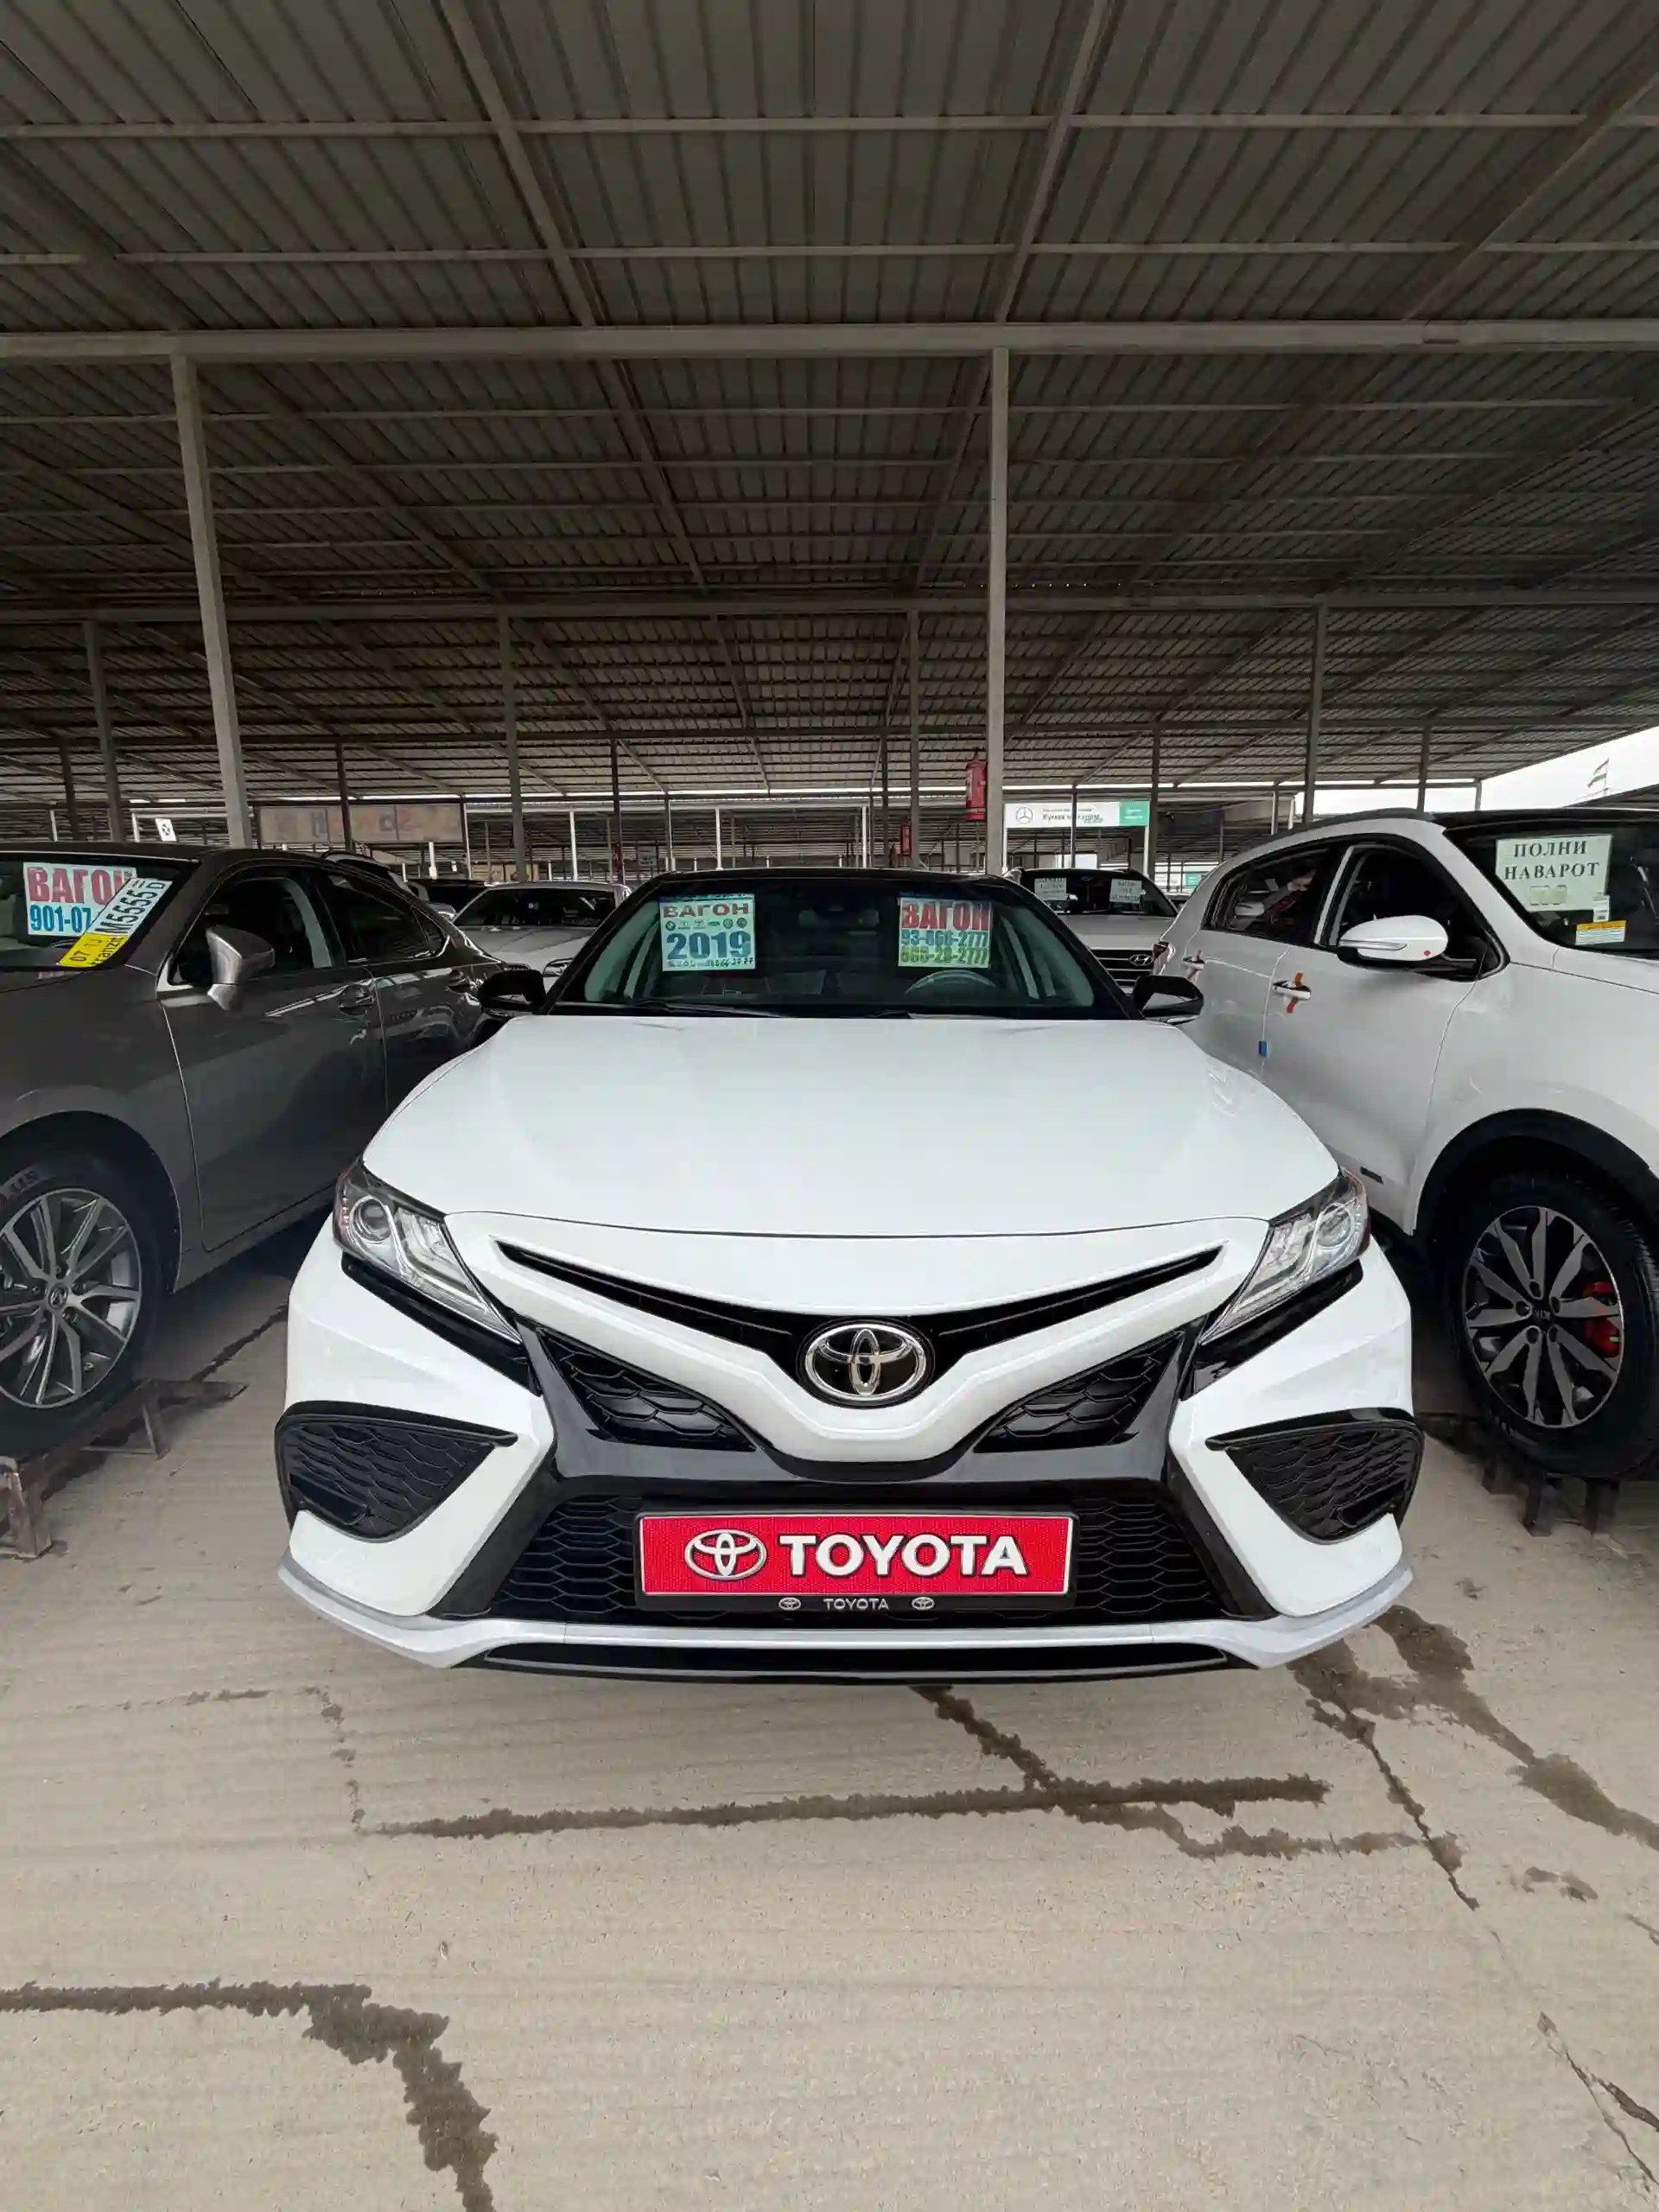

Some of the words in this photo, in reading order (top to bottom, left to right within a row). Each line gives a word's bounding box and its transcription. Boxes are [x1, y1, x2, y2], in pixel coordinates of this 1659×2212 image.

[1514, 840, 1586, 858] ПОЛНИ
[1503, 862, 1599, 880] НАВАРОТ
[664, 903, 749, 918] ВАГОН
[901, 901, 989, 931] ВАГОН
[666, 931, 752, 959] 2019
[779, 1534, 1028, 1577] TOYOTA
[823, 1598, 889, 1611] TOYOTA
